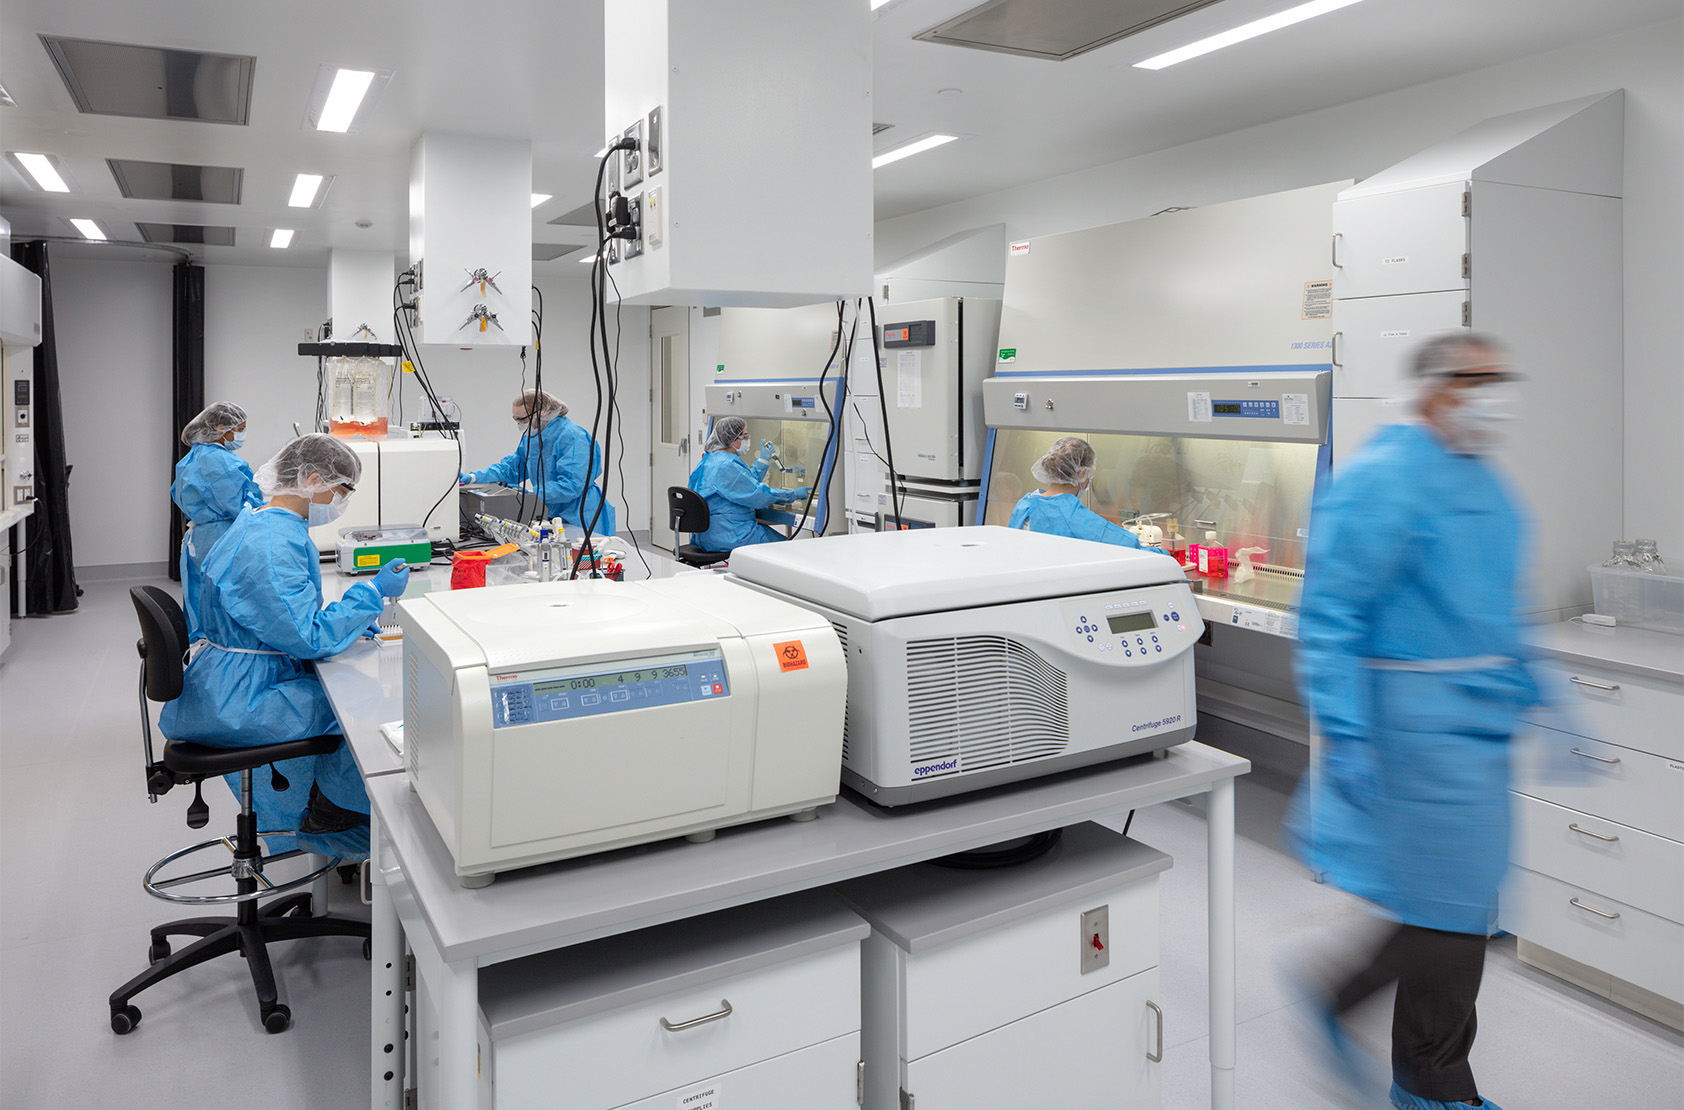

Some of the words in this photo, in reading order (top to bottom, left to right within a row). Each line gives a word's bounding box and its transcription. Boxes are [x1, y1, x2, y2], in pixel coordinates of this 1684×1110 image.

[1290, 342, 1304, 350] 1300
[1303, 341, 1325, 349] SERIES
[782, 659, 806, 668] BIOHAZARD
[570, 678, 596, 690] 0:00
[617, 674, 624, 684] 4
[634, 672, 641, 682] 9
[651, 670, 658, 680] 9
[662, 667, 686, 678] 3655
[1131, 720, 1162, 732] Centrifuge
[1162, 716, 1177, 726] 5920
[914, 759, 958, 776] eppendorf
[682, 1089, 715, 1104] CENTRIFUGE
